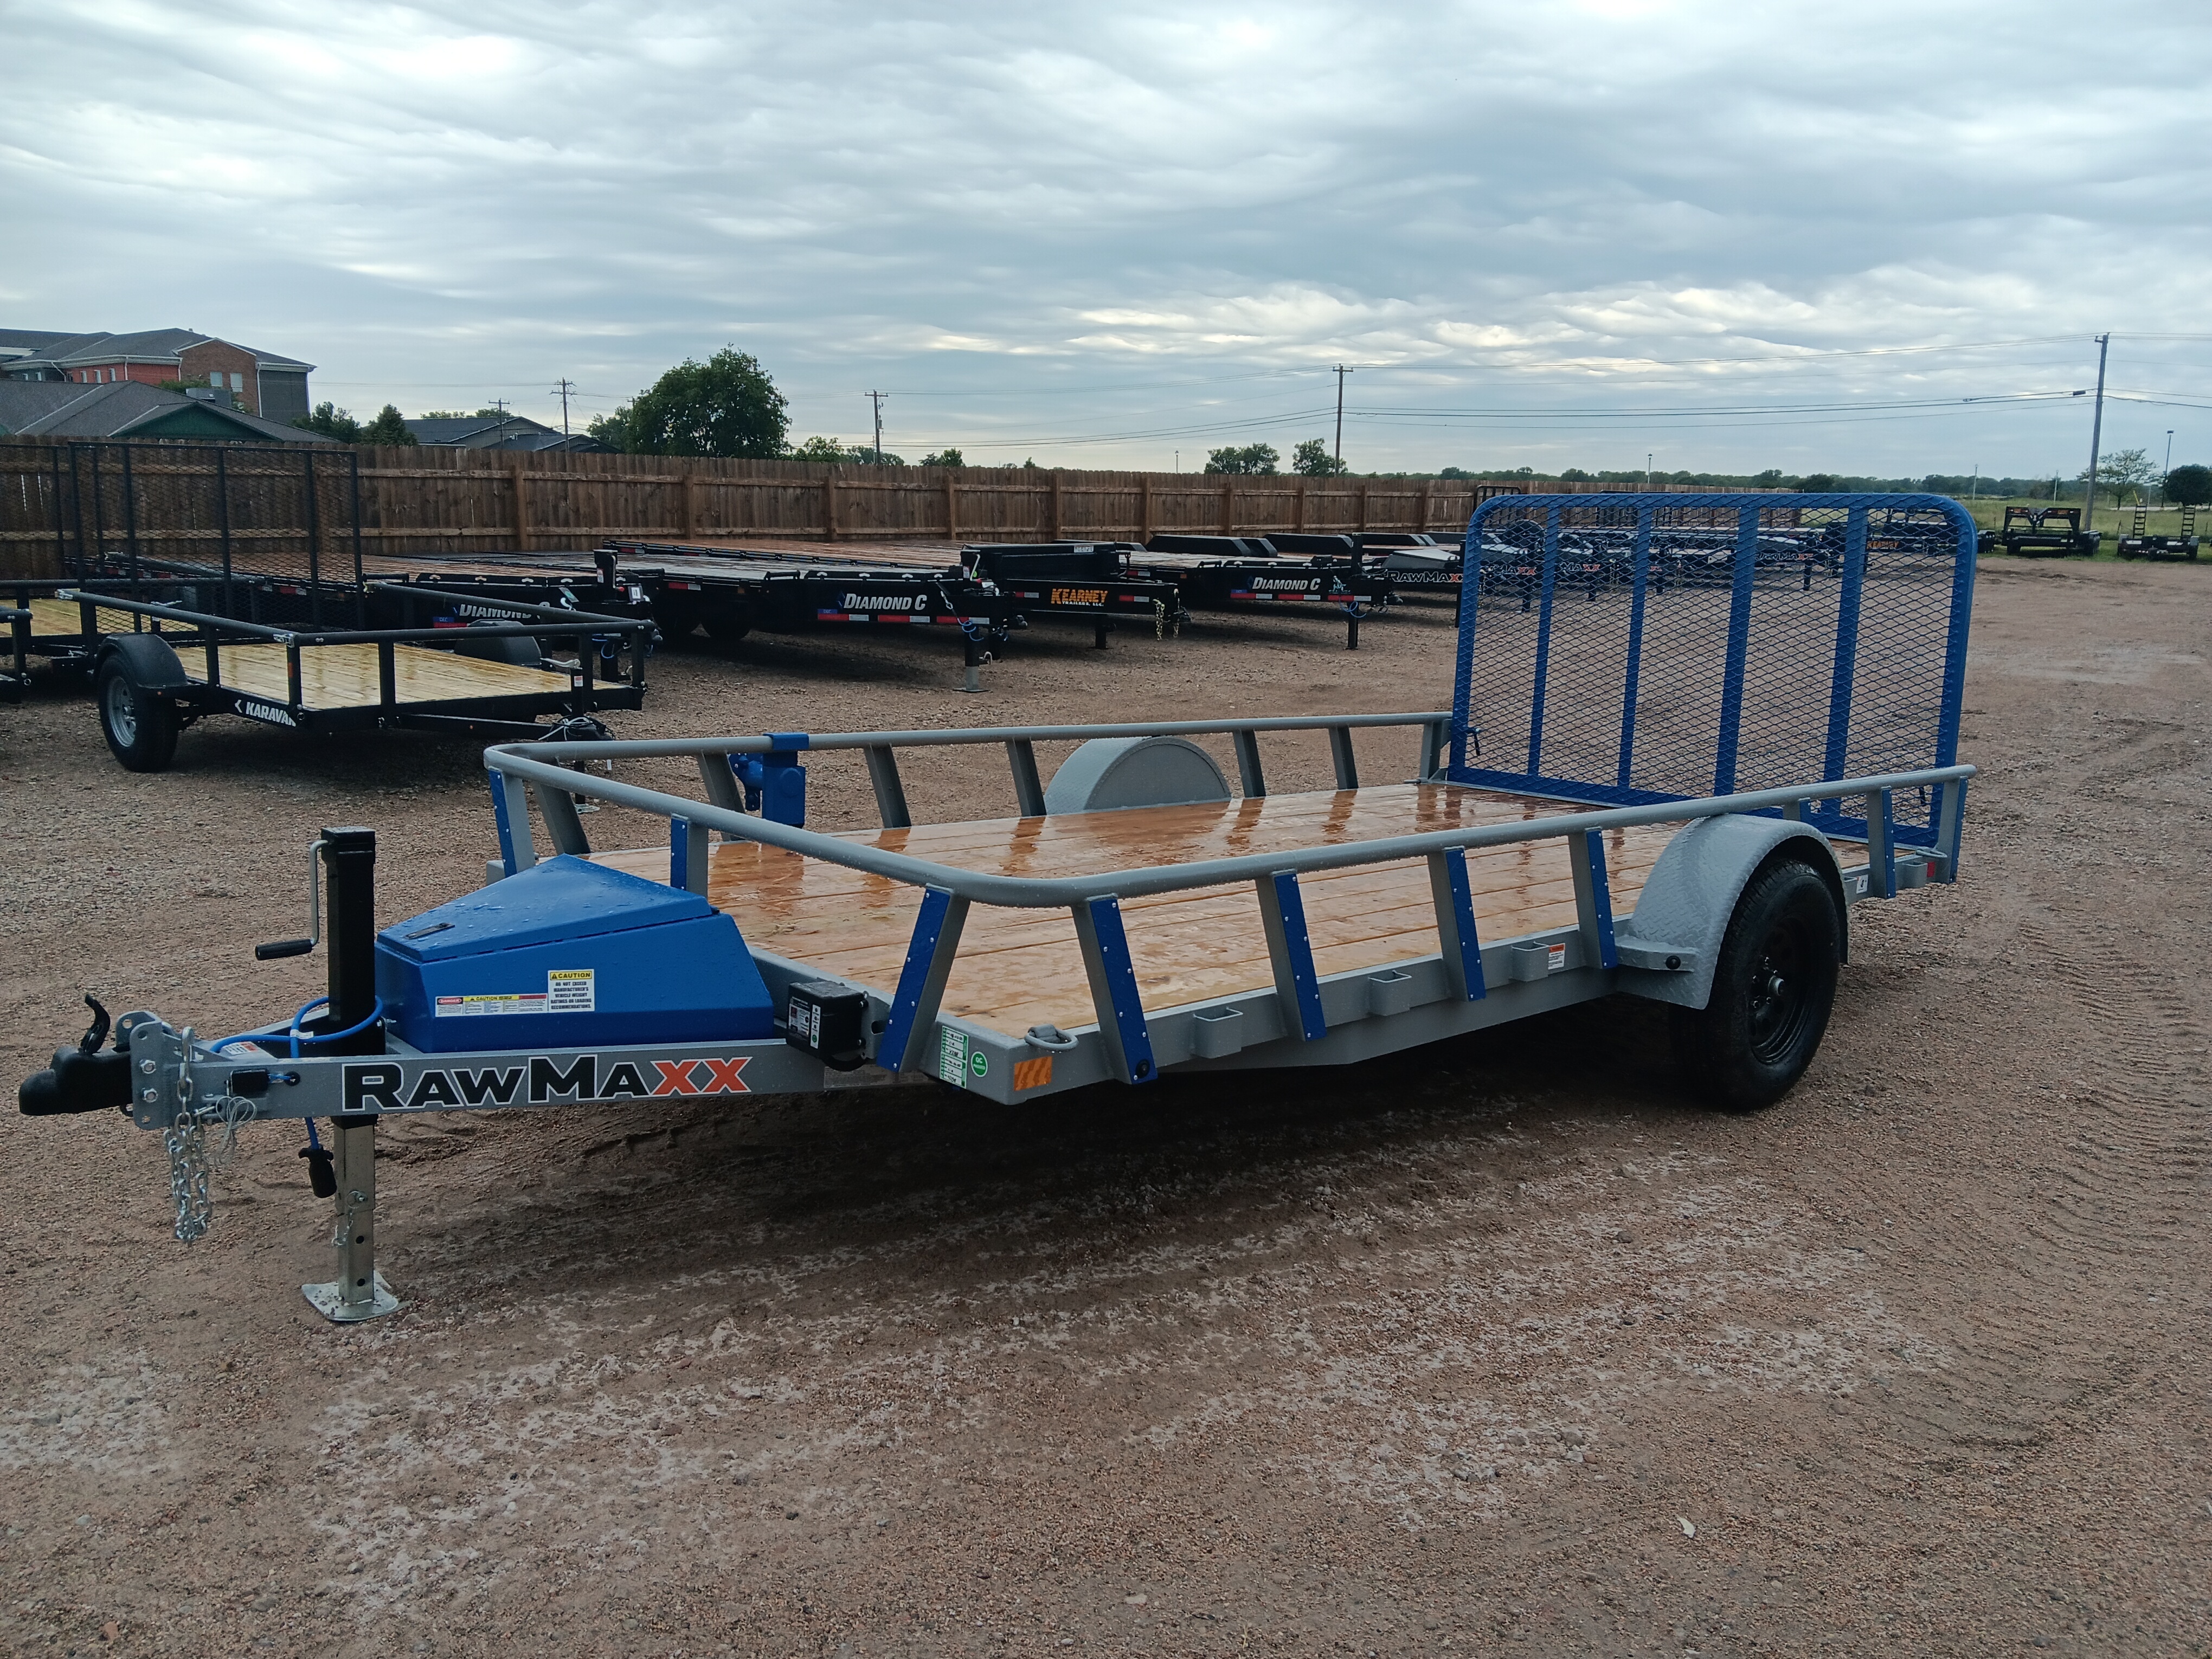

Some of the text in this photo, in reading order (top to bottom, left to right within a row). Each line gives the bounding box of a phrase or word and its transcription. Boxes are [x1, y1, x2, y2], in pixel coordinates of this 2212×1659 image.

[1252, 577, 1321, 590] DIAMOND C
[1387, 571, 1463, 583] RAWMAX
[844, 594, 927, 610] DIAMOND C
[1051, 588, 1108, 605] KEARNEY
[342, 1054, 753, 1112] RAWMAXX
